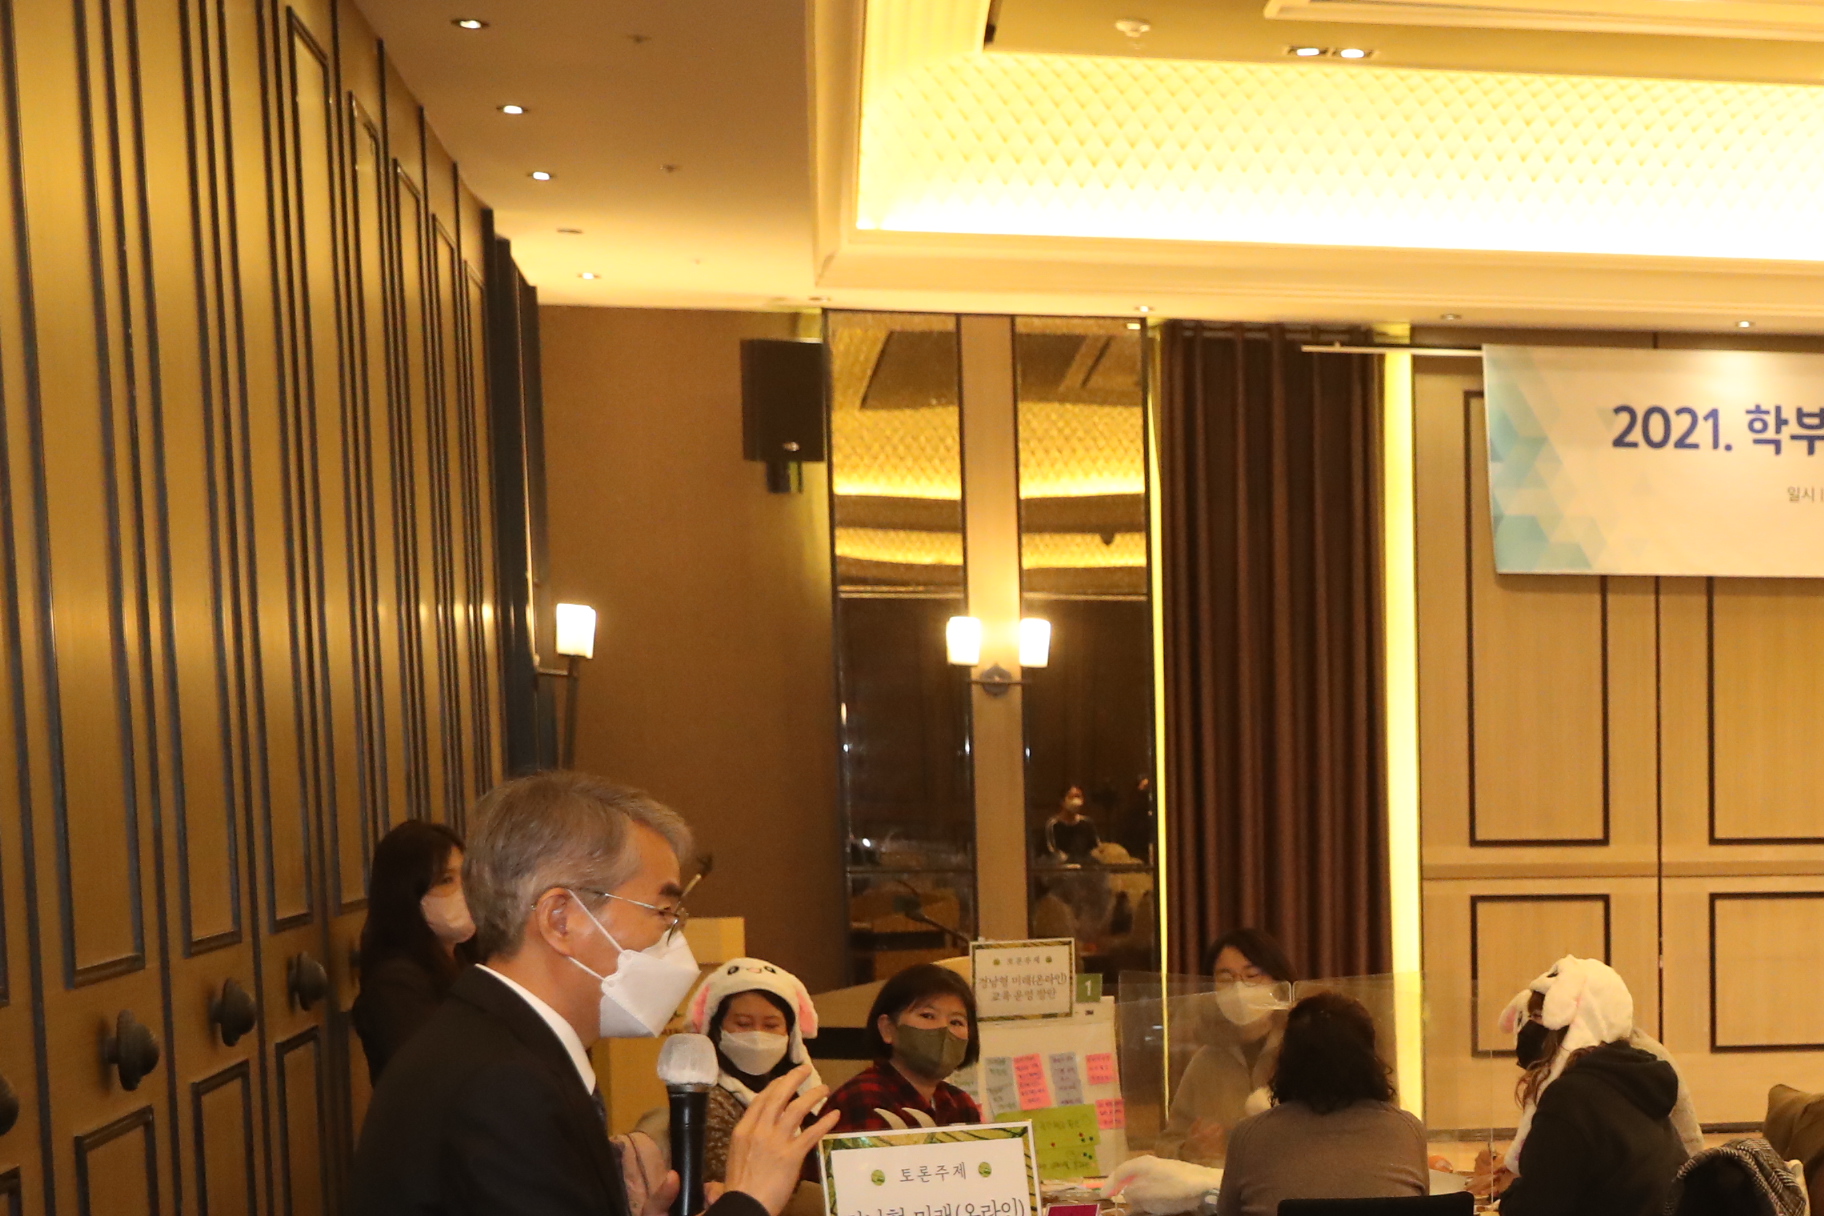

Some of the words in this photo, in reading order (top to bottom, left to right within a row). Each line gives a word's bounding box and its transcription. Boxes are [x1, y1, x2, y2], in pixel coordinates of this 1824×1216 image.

[1612, 405, 1733, 451] 2021.
[1787, 486, 1815, 503] 일시
[1084, 980, 1092, 996] 1
[900, 1162, 967, 1183] 토론주제
